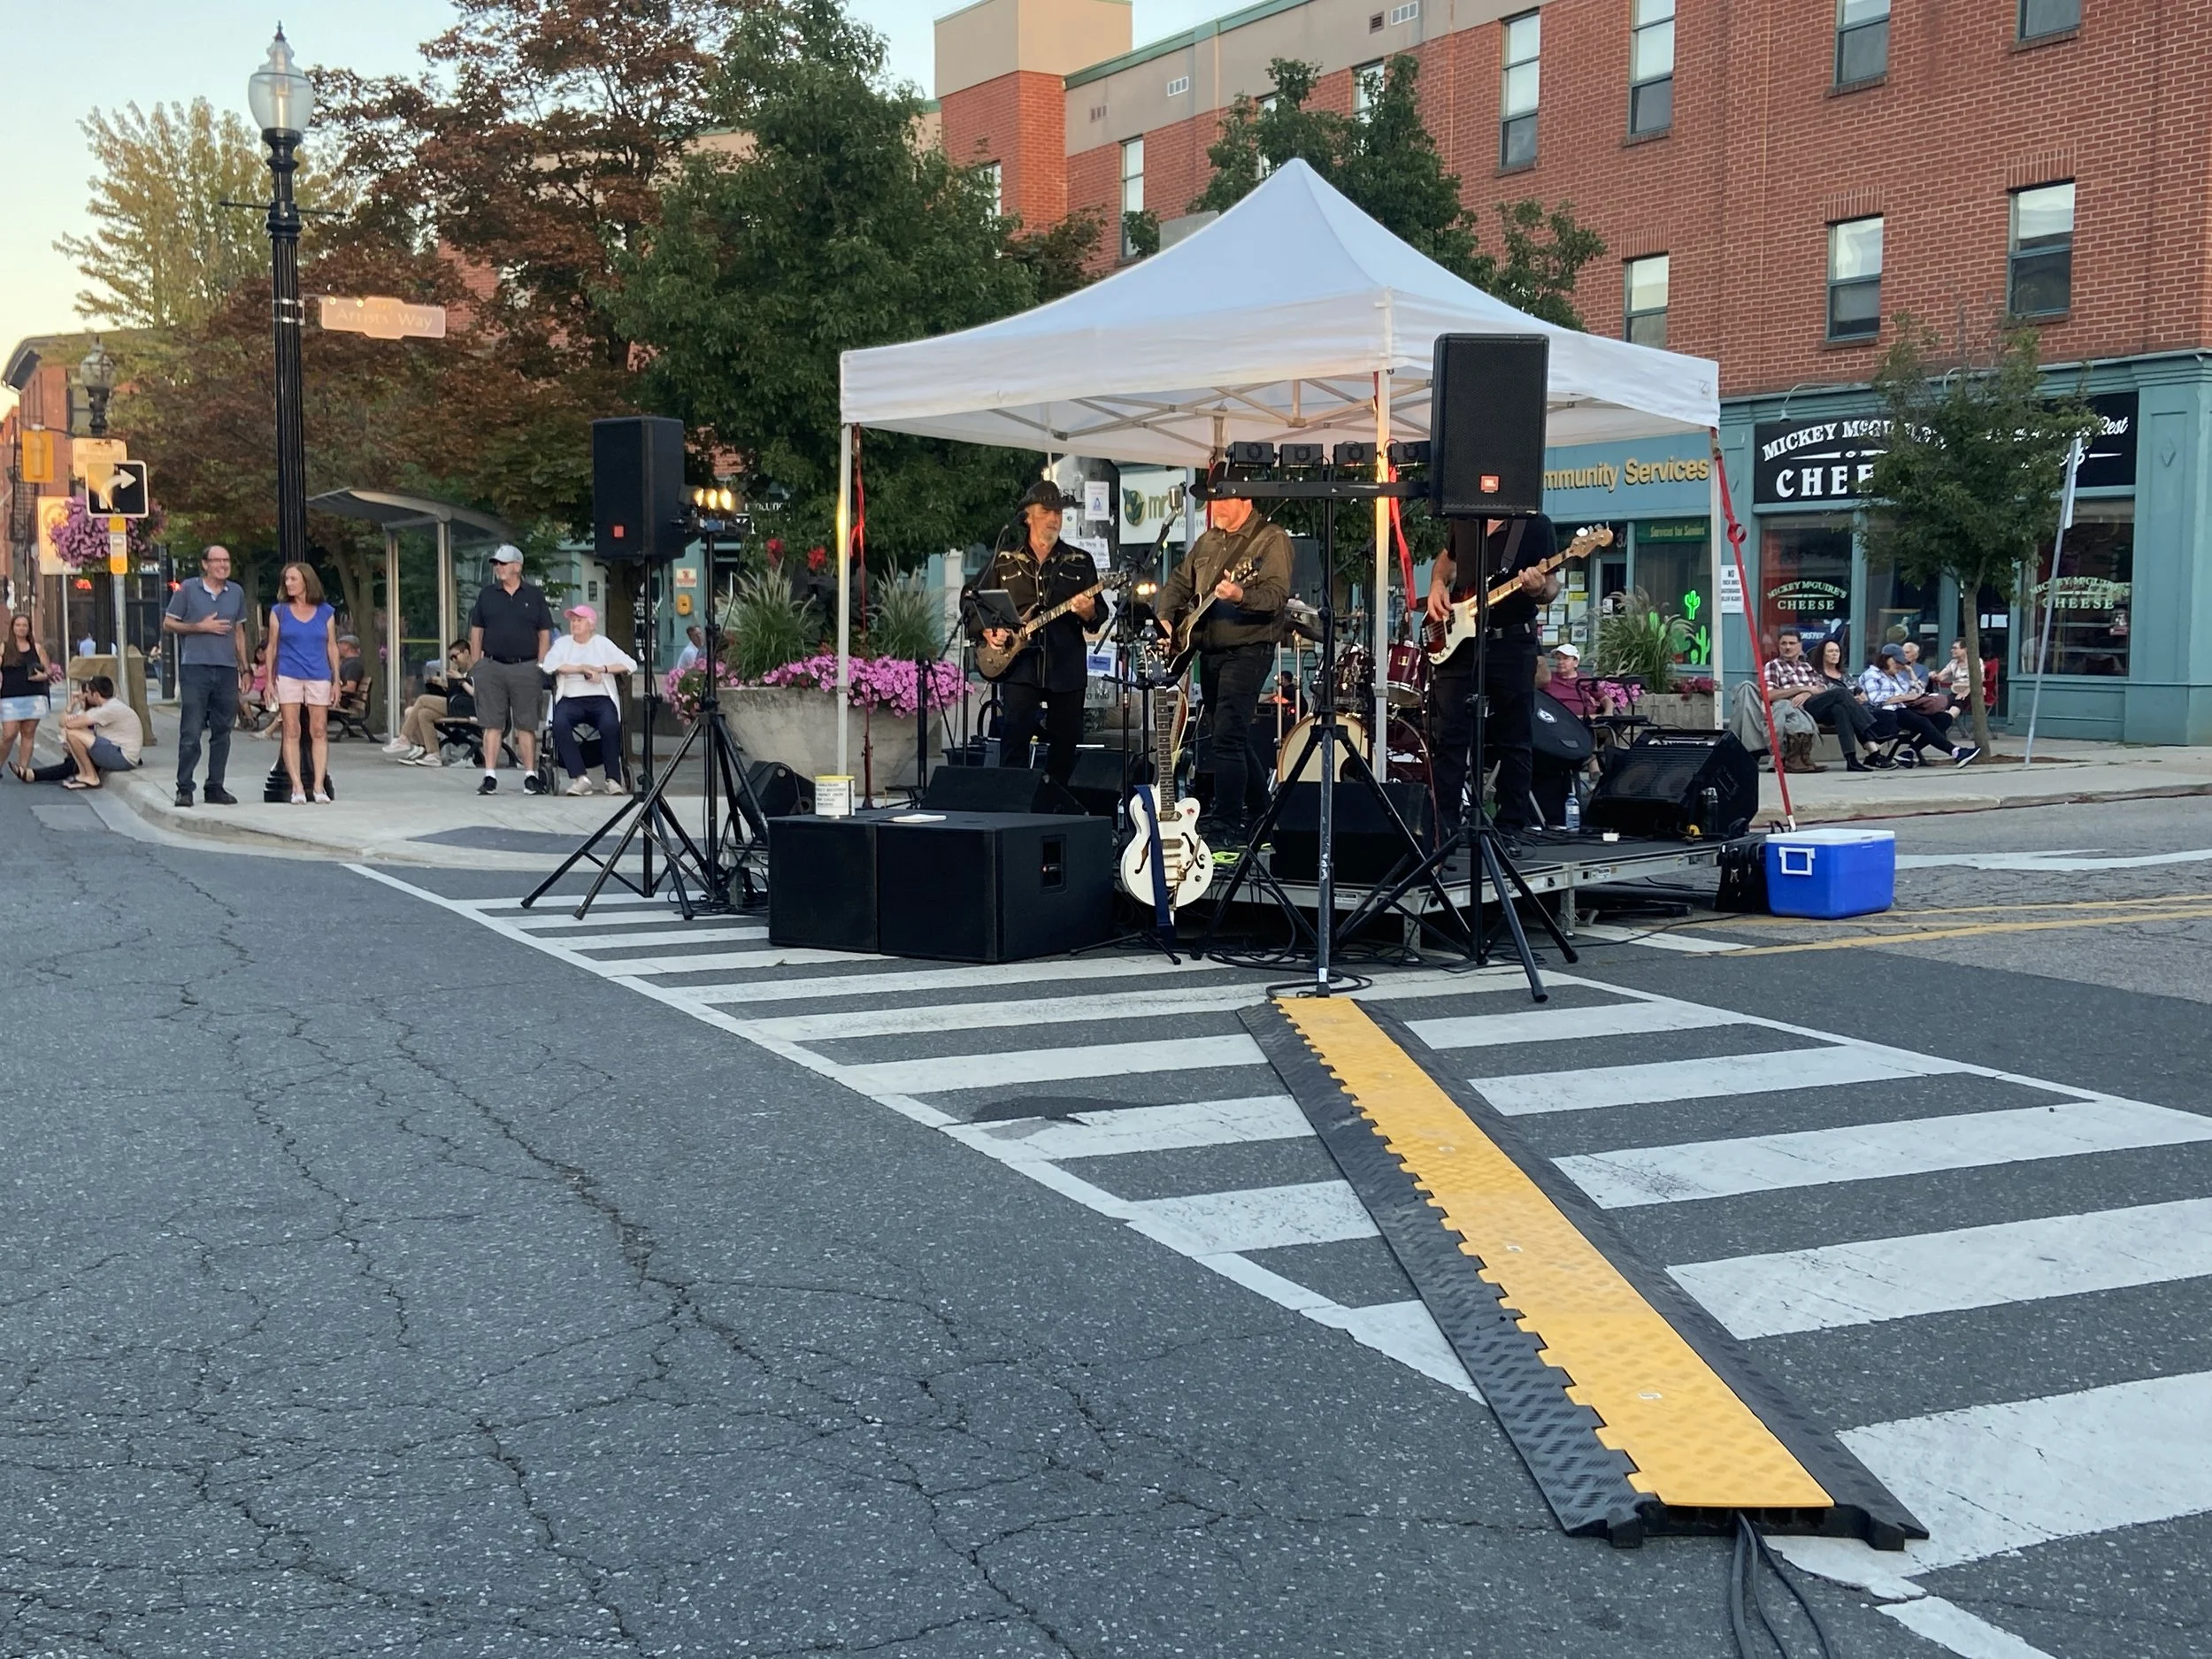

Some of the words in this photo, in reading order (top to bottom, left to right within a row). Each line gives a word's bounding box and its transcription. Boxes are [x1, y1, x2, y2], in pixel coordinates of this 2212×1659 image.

[397, 311, 433, 331] Way
[1762, 421, 1838, 462] MICKEY
[1543, 461, 1620, 493] mmunity
[1624, 456, 1709, 486] Services
[1776, 463, 1874, 498] CHEE
[1767, 580, 1801, 600] MICKEY
[2029, 577, 2072, 595] MICEY
[1777, 600, 1835, 611] CHEESE
[2042, 597, 2115, 610] CHEESE
